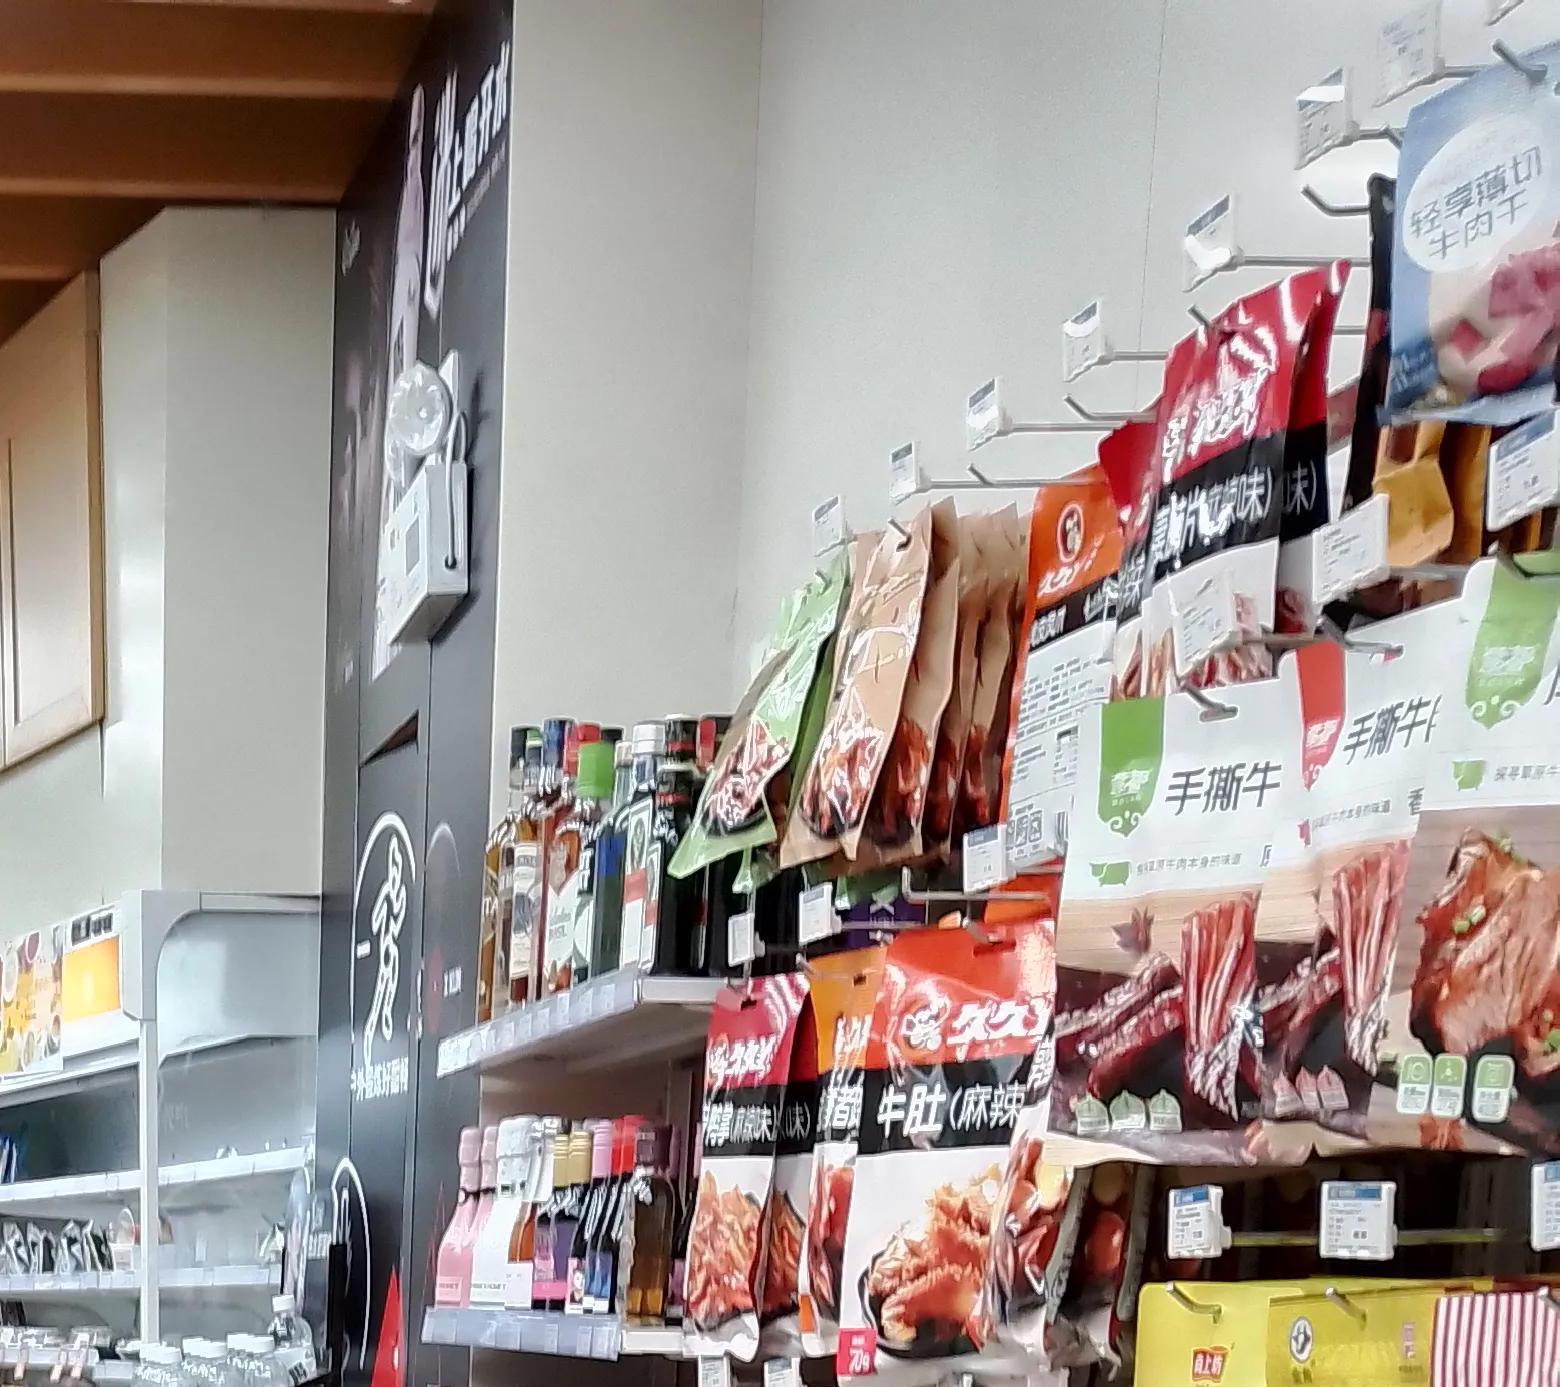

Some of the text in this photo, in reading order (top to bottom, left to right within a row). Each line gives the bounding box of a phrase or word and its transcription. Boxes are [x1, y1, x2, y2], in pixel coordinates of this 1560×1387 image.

[1410, 144, 1542, 239] 轻享薄切
[1427, 188, 1531, 260] 牛肉干
[1164, 760, 1283, 817] 手撕牛
[876, 1081, 1026, 1138] 牛肚(麻辣
